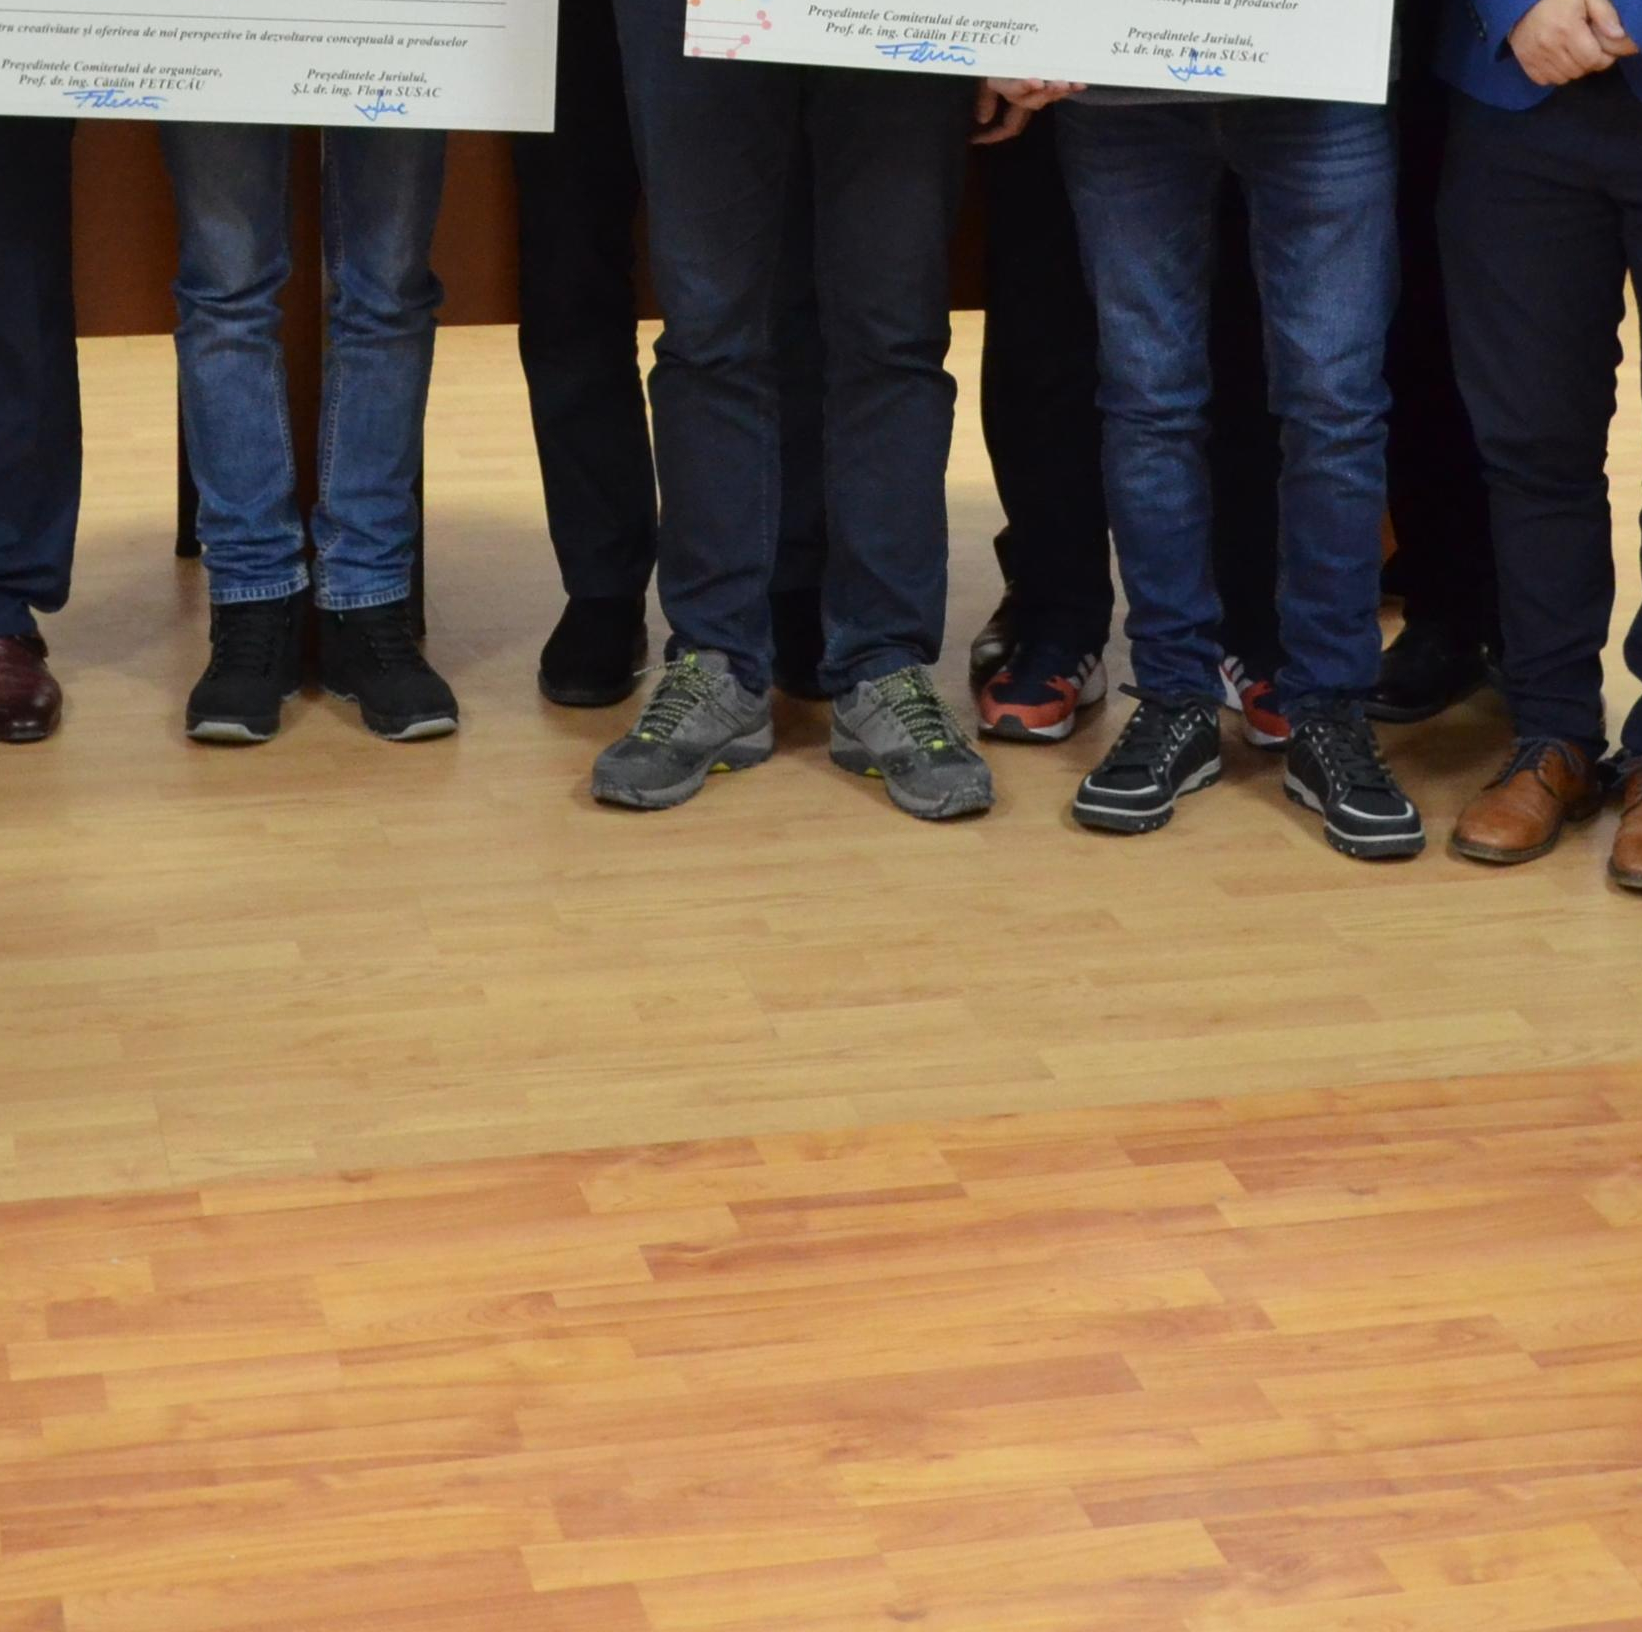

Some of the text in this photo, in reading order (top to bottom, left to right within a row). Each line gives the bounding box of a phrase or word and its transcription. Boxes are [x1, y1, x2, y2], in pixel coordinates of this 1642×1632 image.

[882, 10, 953, 25] Comitetului
[954, 14, 970, 27] de
[16, 23, 80, 35] creativitate
[94, 25, 140, 37] oferirea
[141, 25, 157, 37] de
[158, 27, 178, 38] noi
[178, 29, 242, 41] perspective
[259, 30, 323, 43] dezvoltarea
[396, 37, 405, 46] a
[405, 35, 468, 48] produselor
[1219, 48, 1268, 63] SUSAC
[73, 60, 140, 73] Comitetului
[141, 62, 156, 74] de
[394, 85, 441, 98] SUSAC
